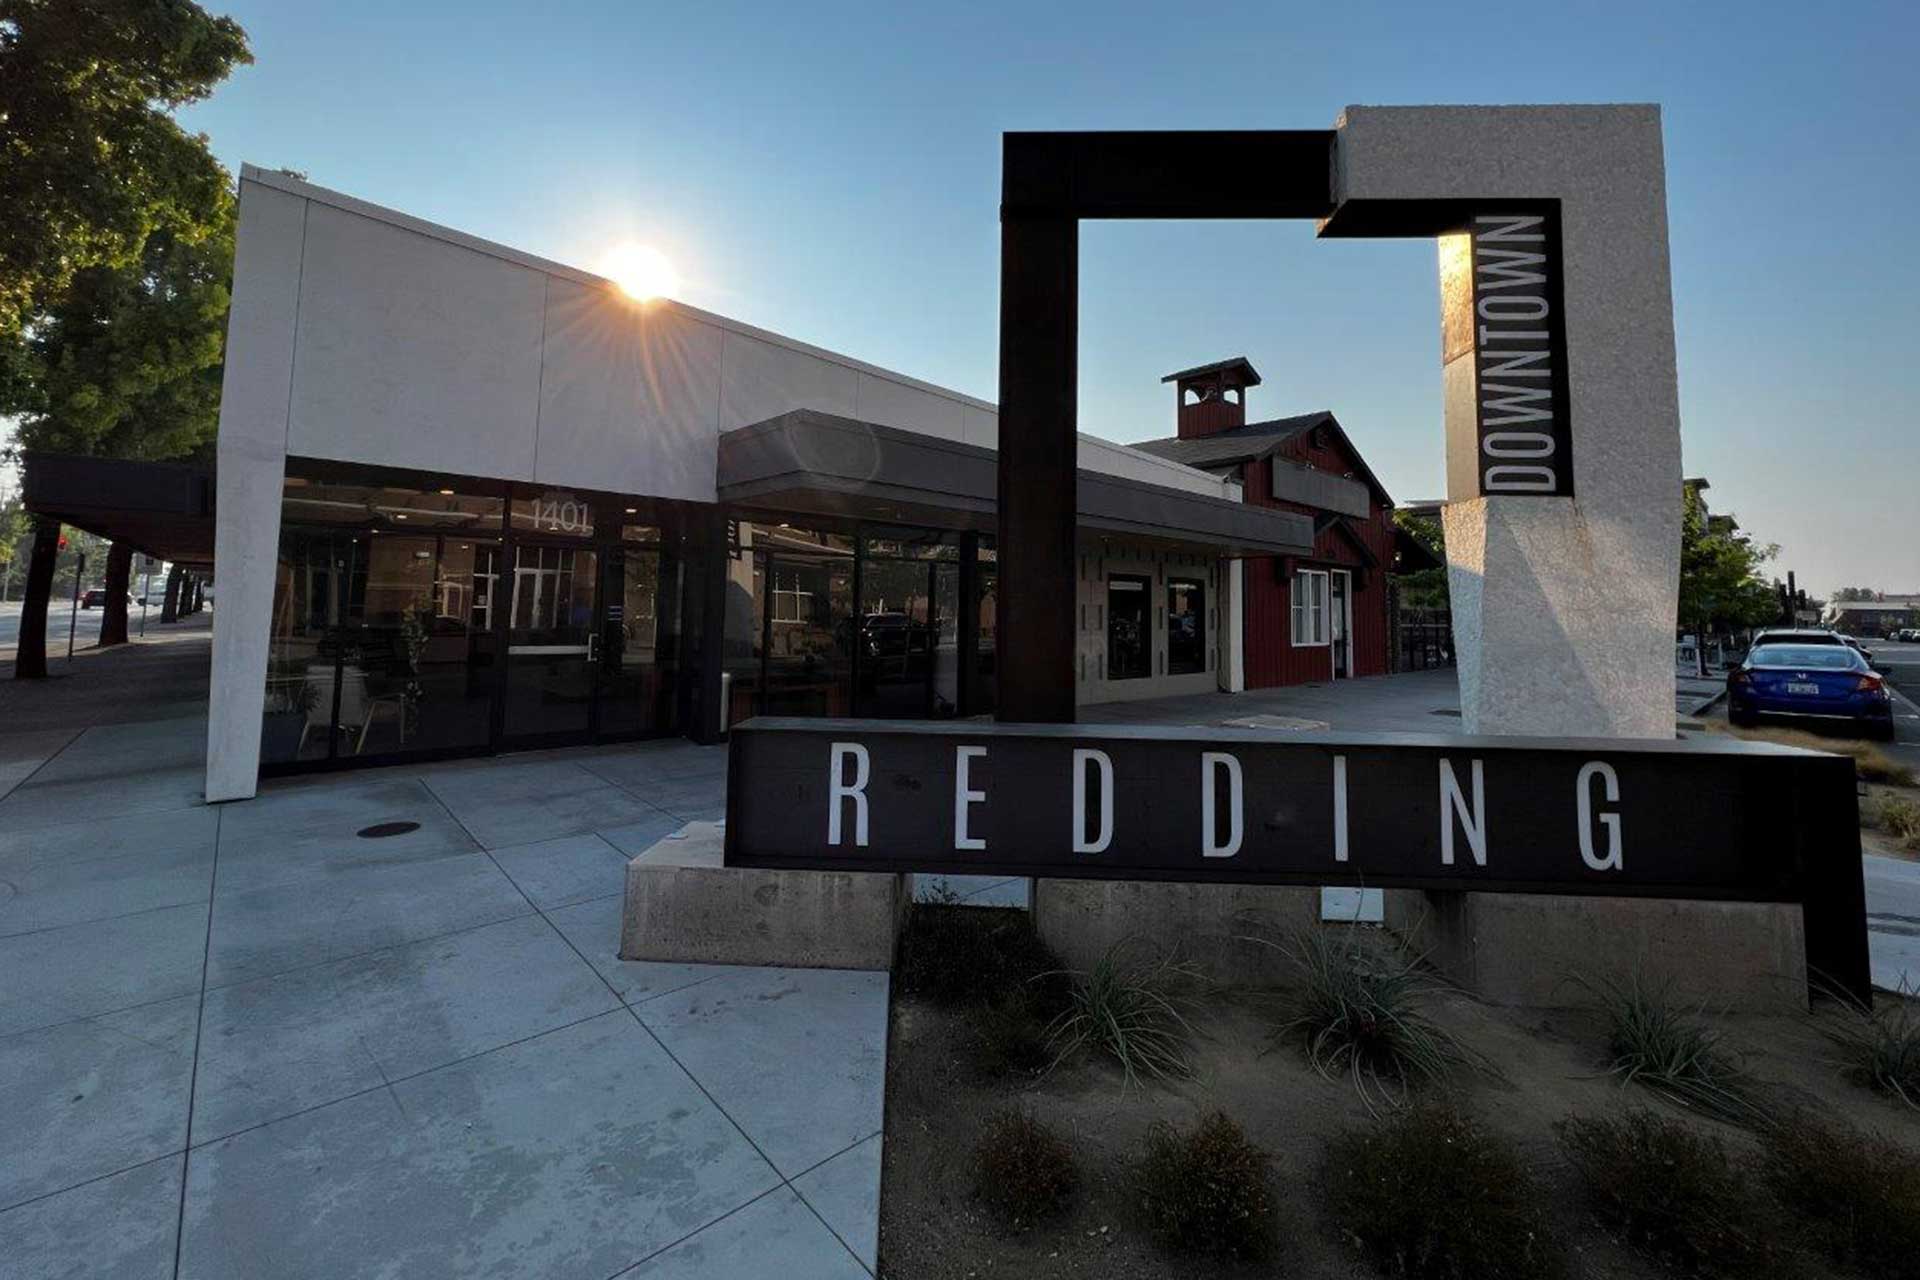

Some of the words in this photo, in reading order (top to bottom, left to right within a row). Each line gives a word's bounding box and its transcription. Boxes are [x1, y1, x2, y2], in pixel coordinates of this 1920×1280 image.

[1475, 215, 1556, 492] DOWNTOWN
[532, 498, 588, 533] 1401
[827, 741, 1625, 872] REDDING
